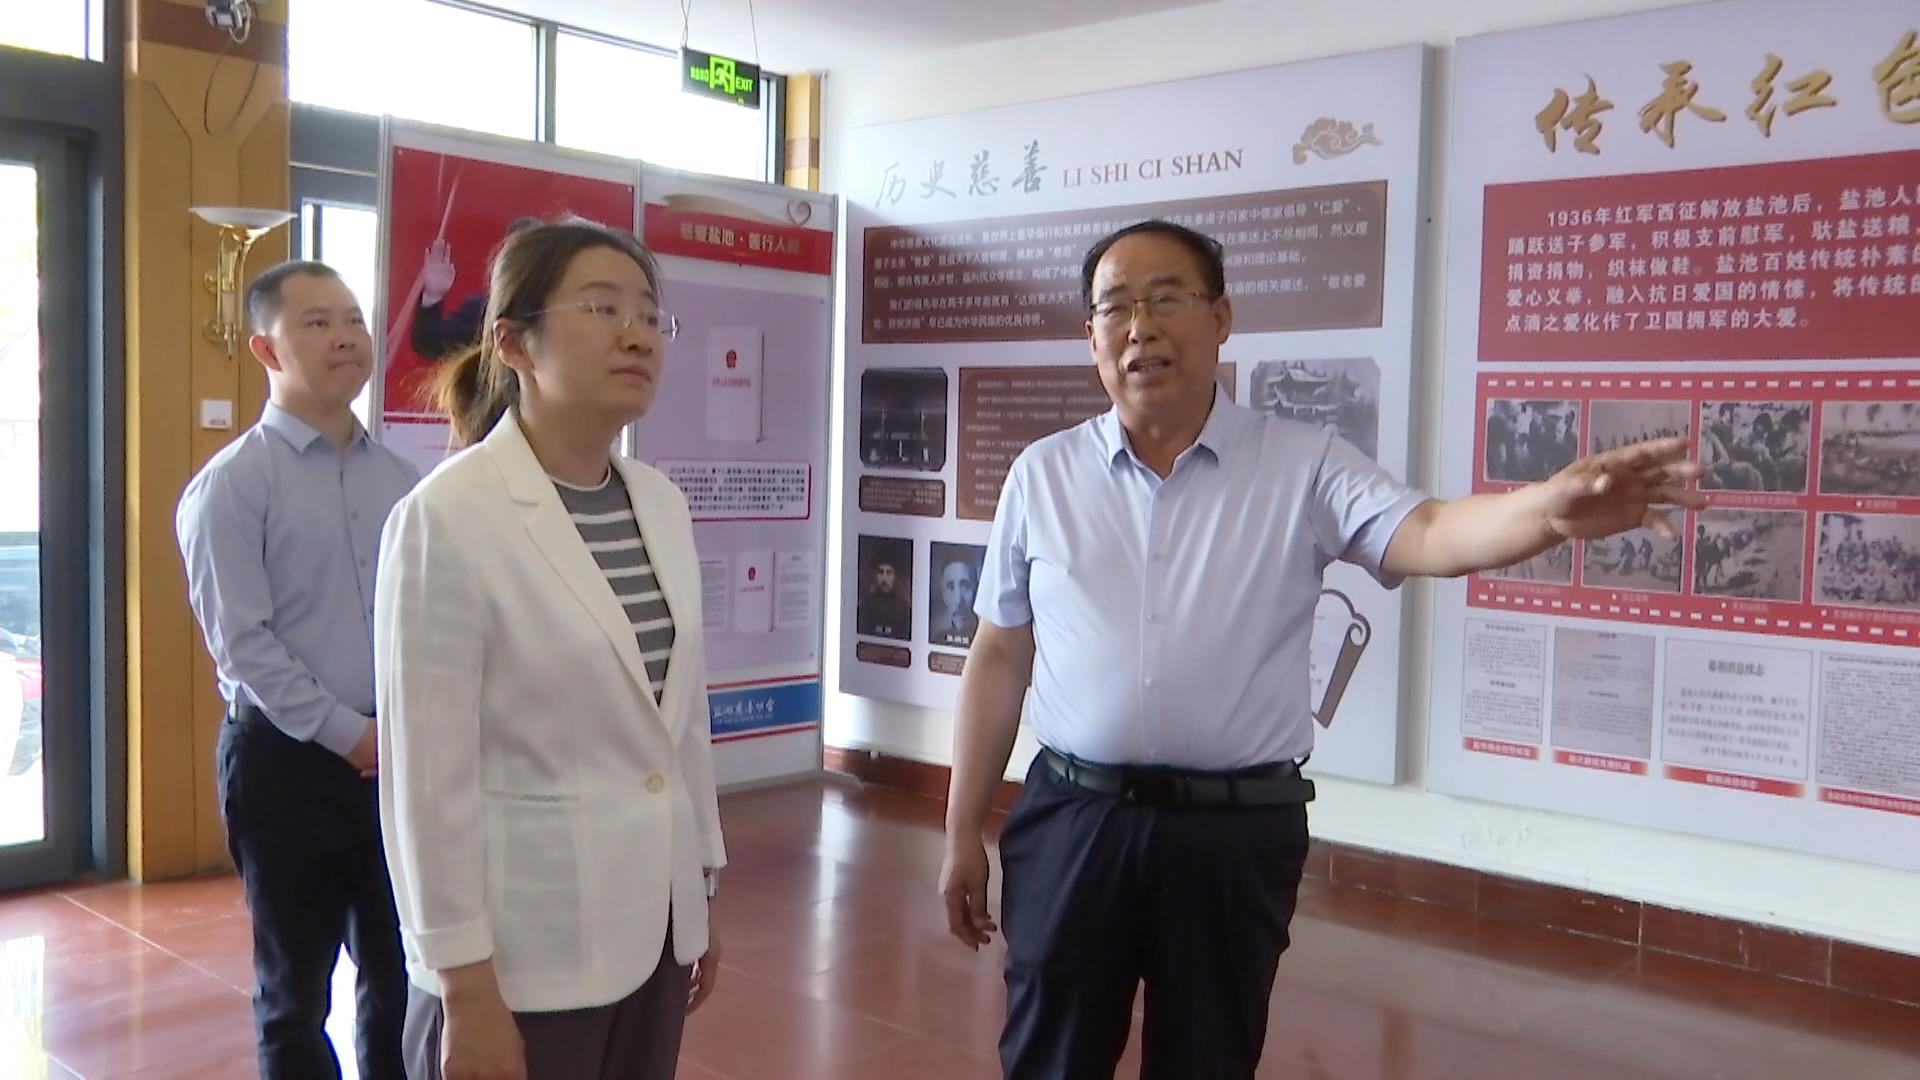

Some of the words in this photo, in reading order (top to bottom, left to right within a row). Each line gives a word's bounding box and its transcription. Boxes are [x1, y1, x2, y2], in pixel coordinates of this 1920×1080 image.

[736, 77, 753, 92] EXIT
[875, 139, 1048, 208] 历史慈善
[1063, 168, 1082, 188] LI
[1090, 162, 1129, 183] SHI
[1138, 159, 1162, 180] CI
[1171, 149, 1244, 176] SHAN
[1505, 306, 1809, 333] 点滴之爱化作了卫国拥军的大爱。
